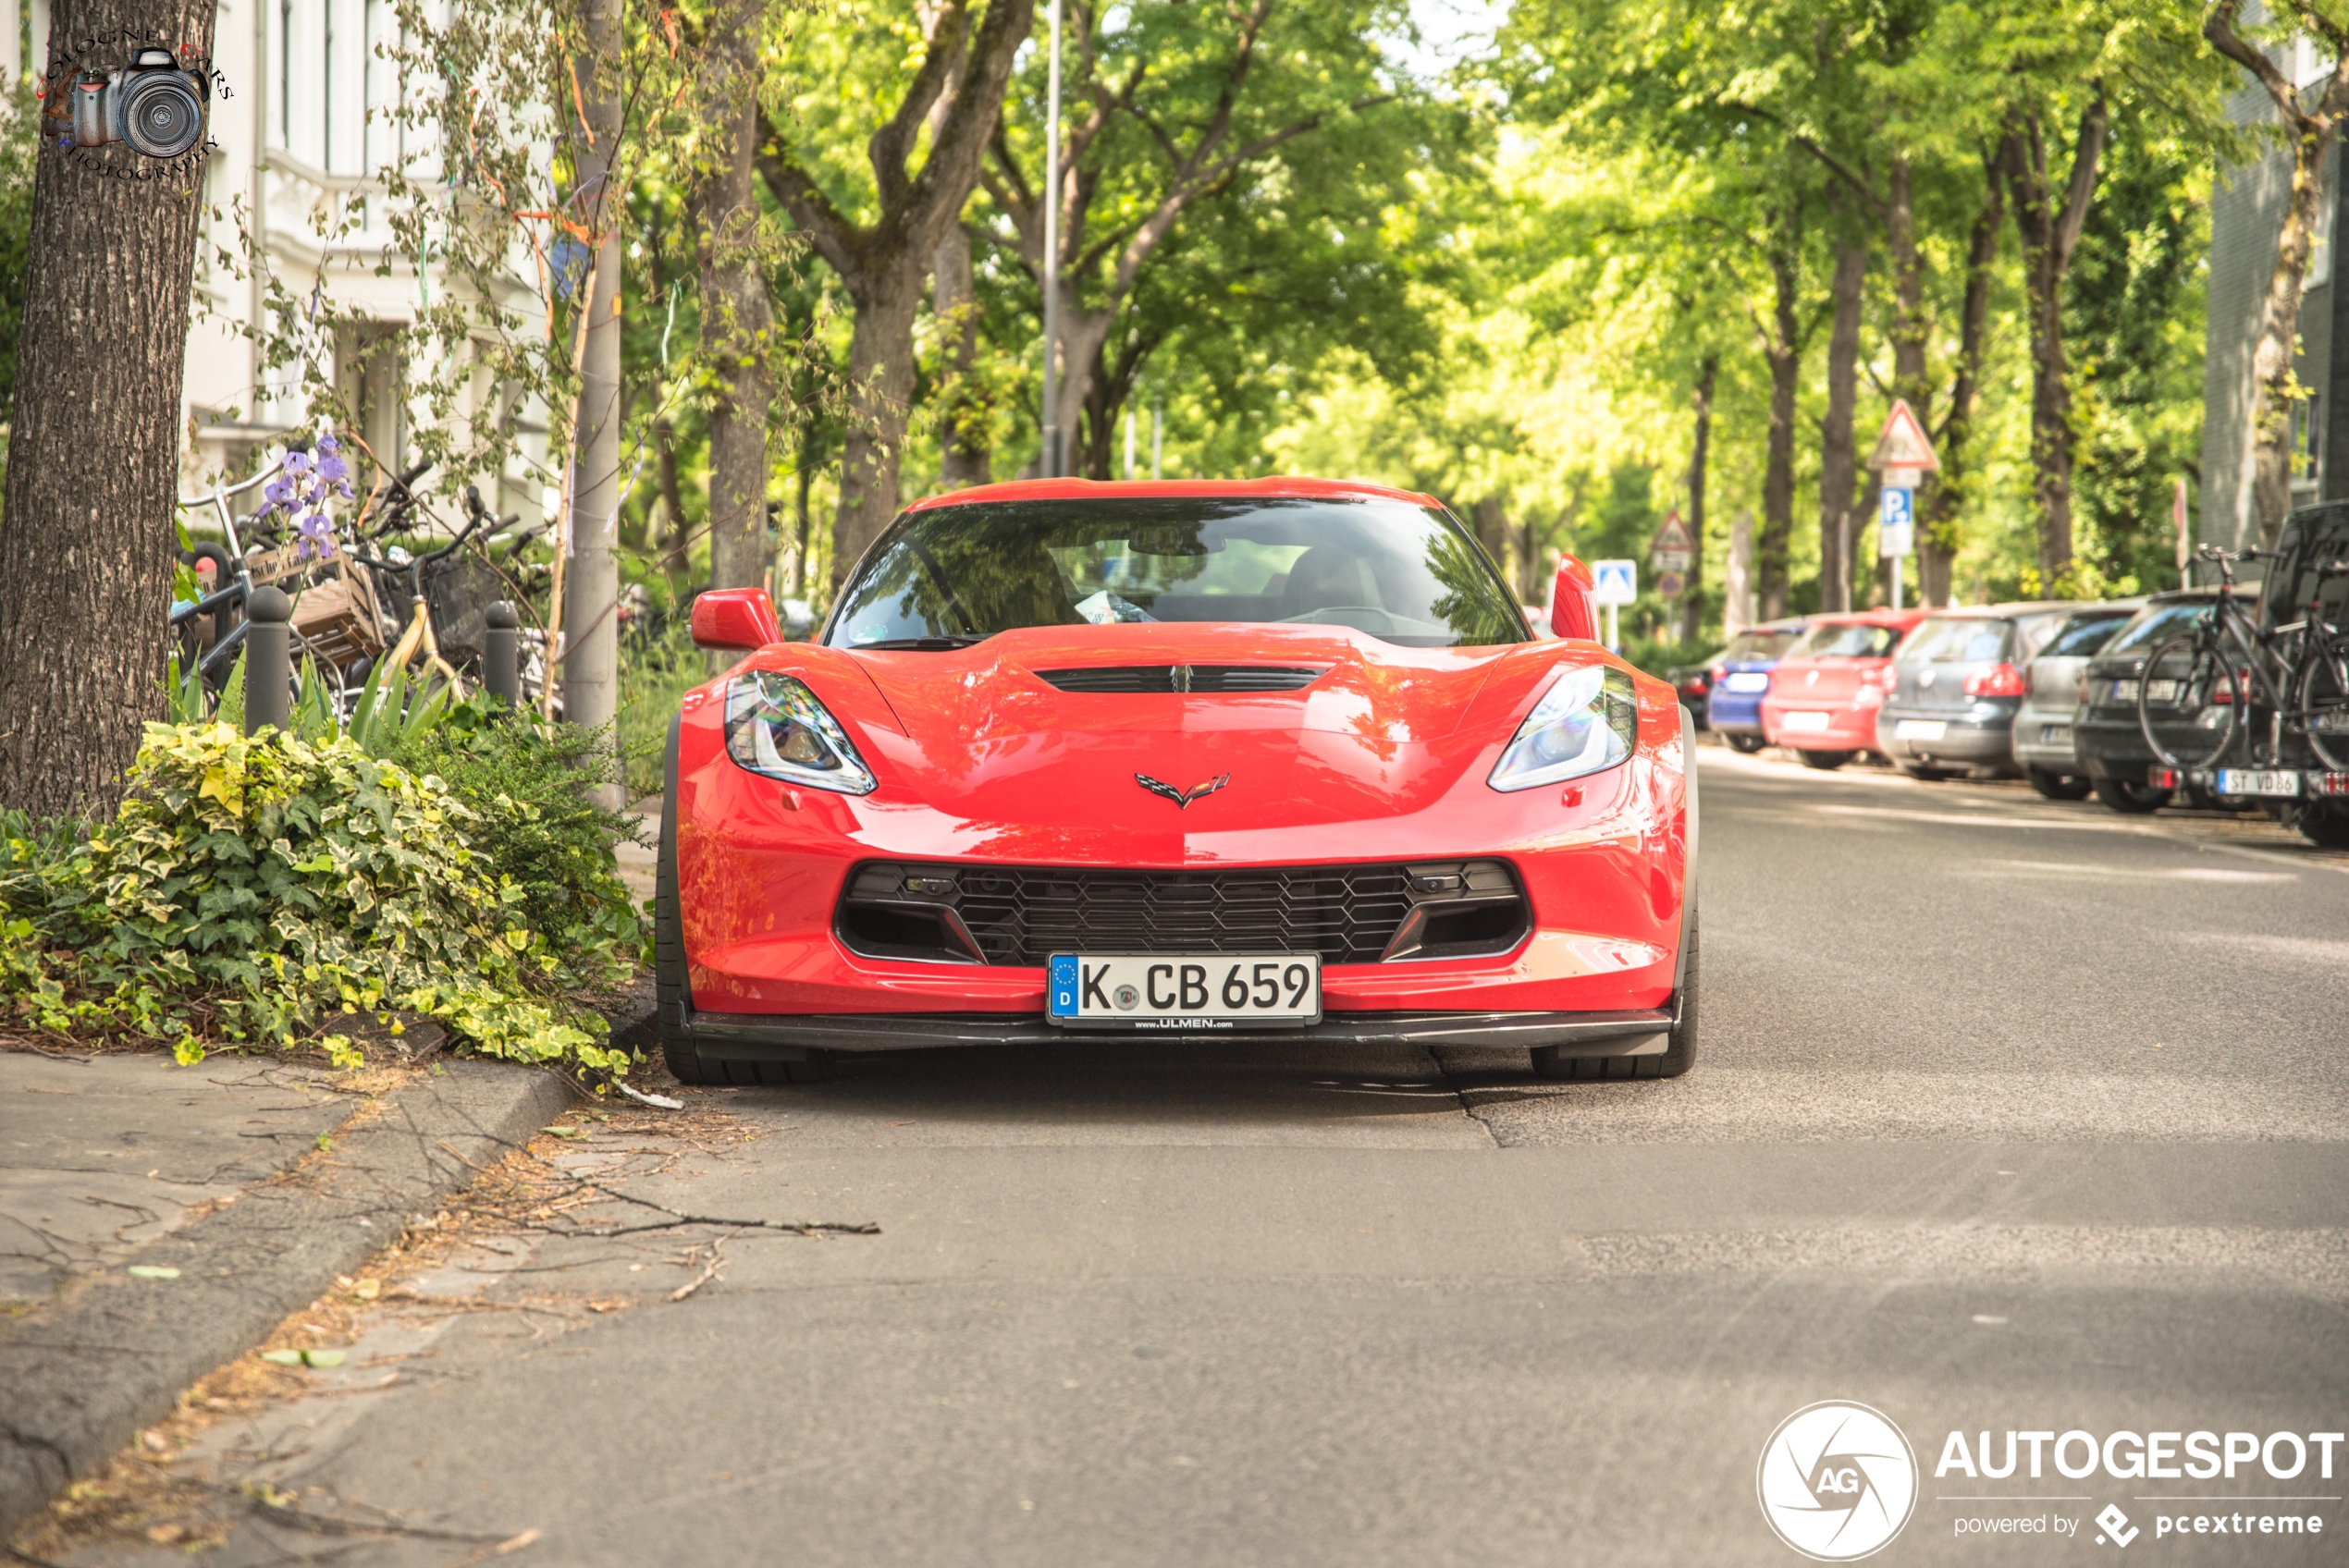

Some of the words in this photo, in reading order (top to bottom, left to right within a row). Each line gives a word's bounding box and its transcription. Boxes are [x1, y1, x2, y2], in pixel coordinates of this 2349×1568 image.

[2231, 775, 2248, 790] ST
[2257, 775, 2274, 790] VD
[1082, 963, 1112, 1010] K
[1147, 964, 1209, 1010] CB
[1222, 963, 1310, 1010] 659
[1060, 992, 1071, 1006] D
[1135, 1019, 1234, 1029] www.ULMEN.com
